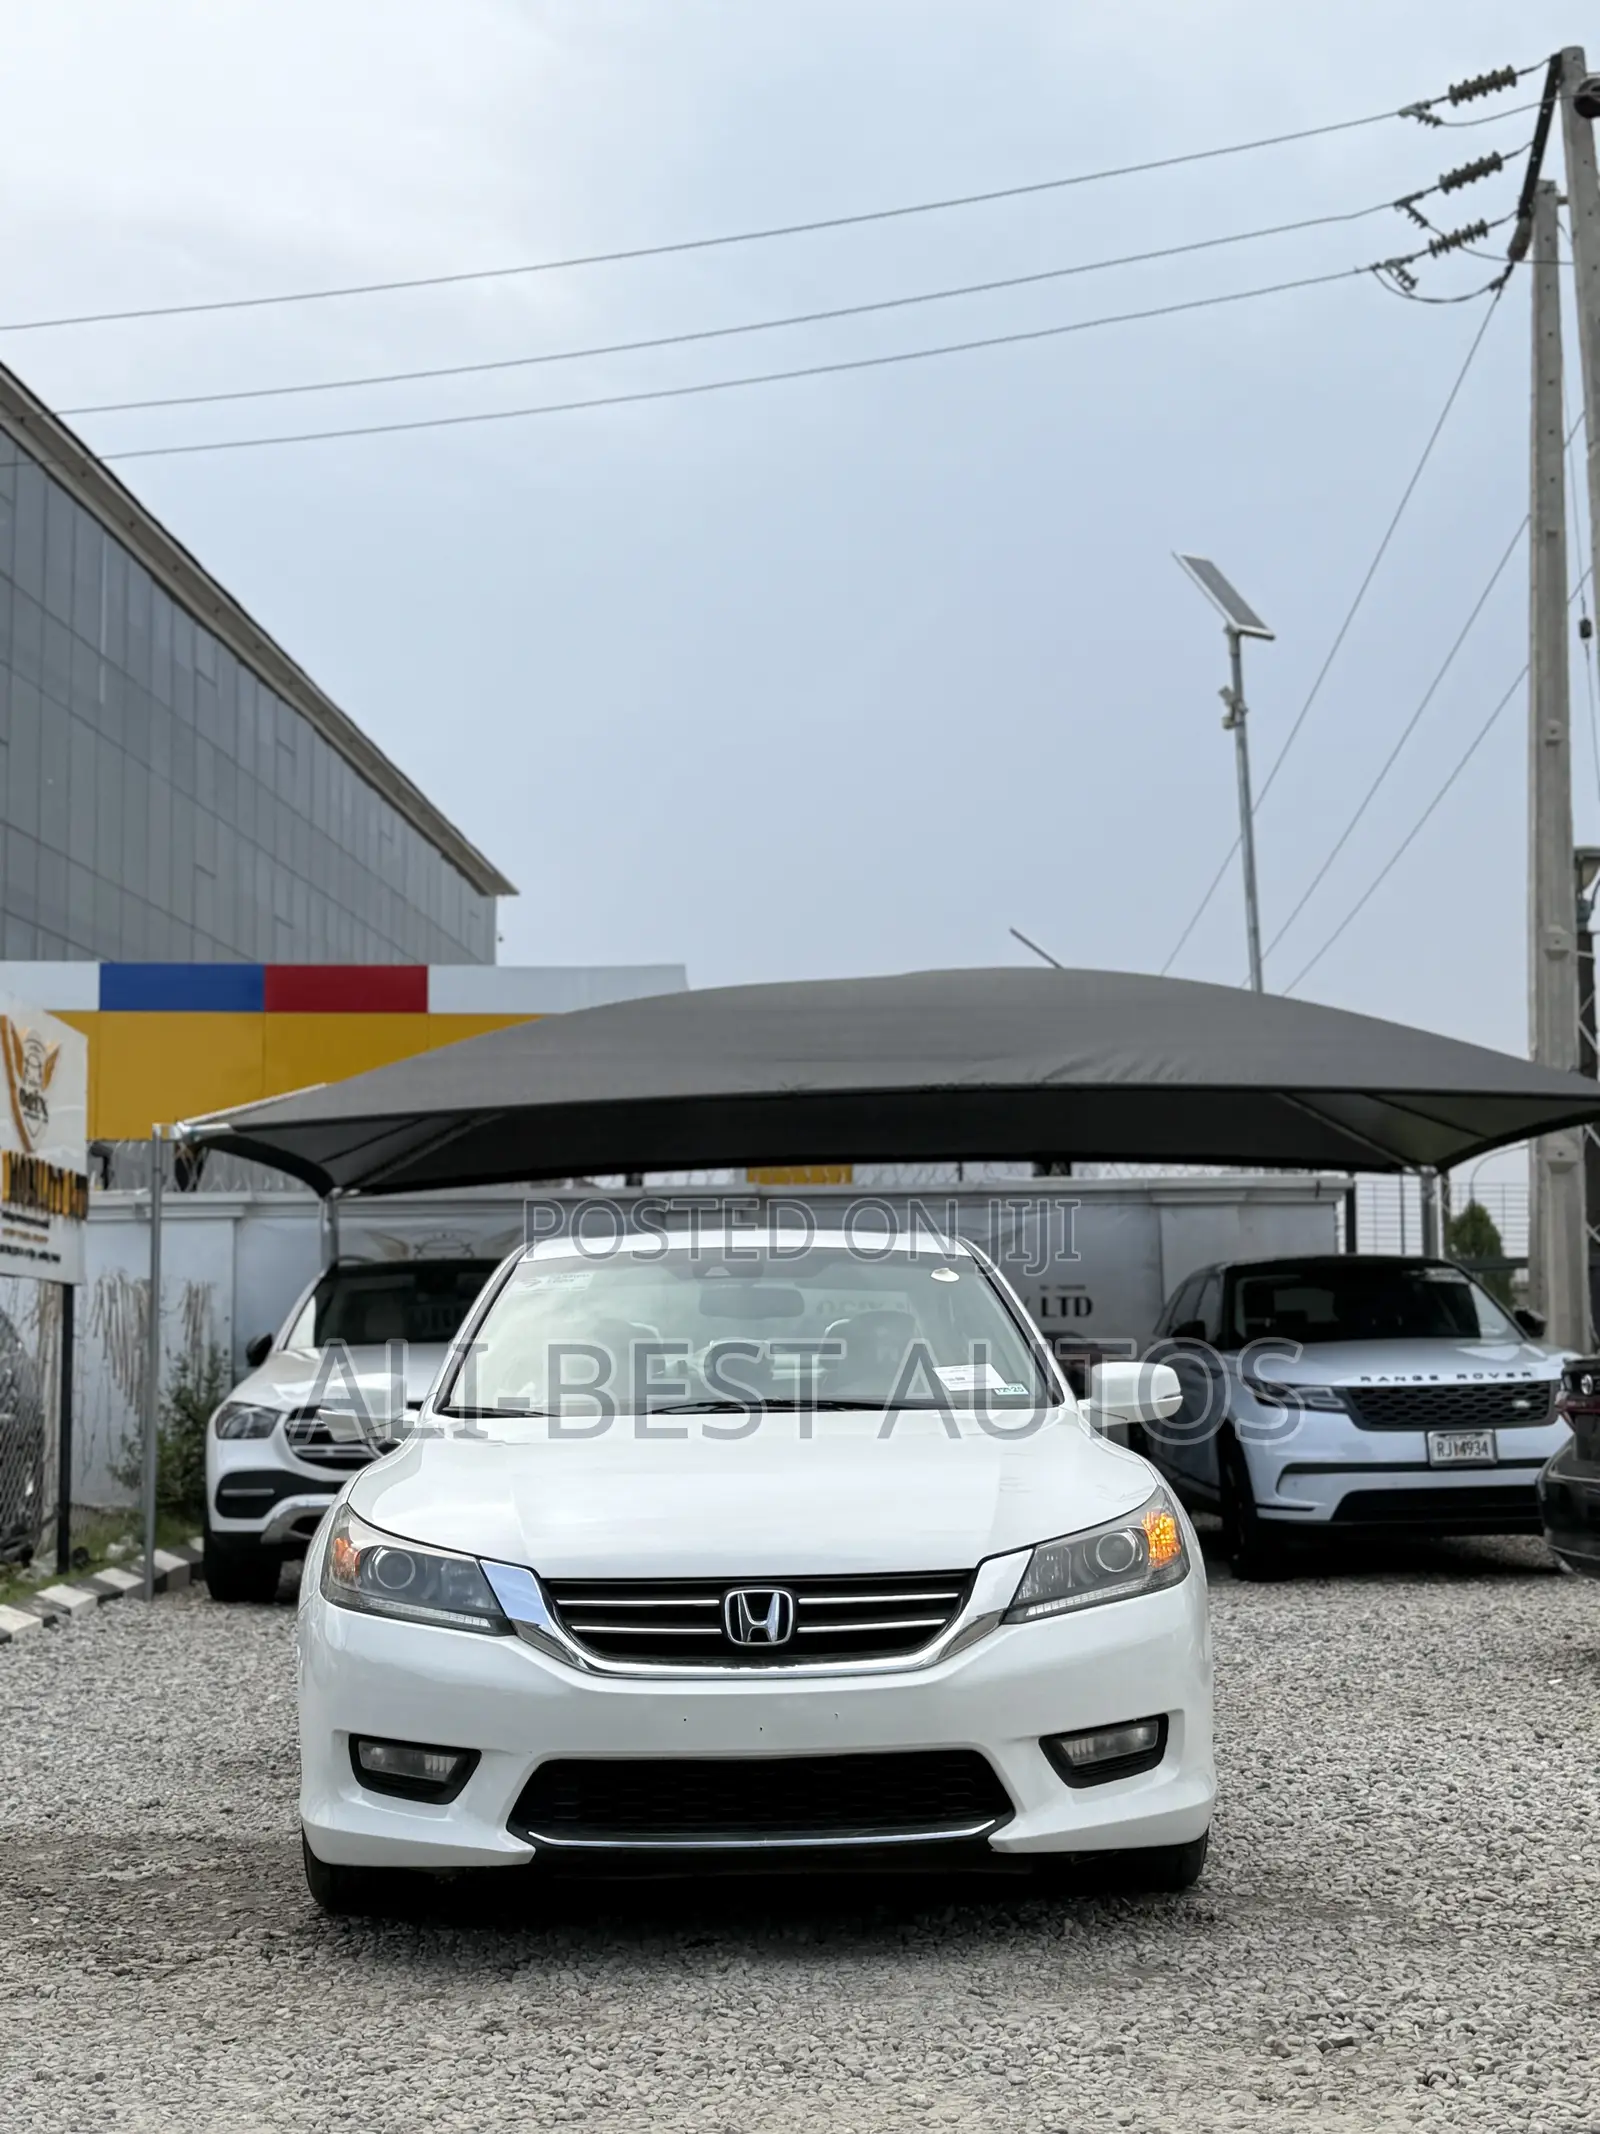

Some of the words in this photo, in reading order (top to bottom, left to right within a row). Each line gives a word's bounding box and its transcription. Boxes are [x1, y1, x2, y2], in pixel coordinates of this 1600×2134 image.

[1041, 1296, 1093, 1318] LTD
[1360, 1374, 1439, 1382] RANGE
[1456, 1371, 1533, 1381] ROVER
